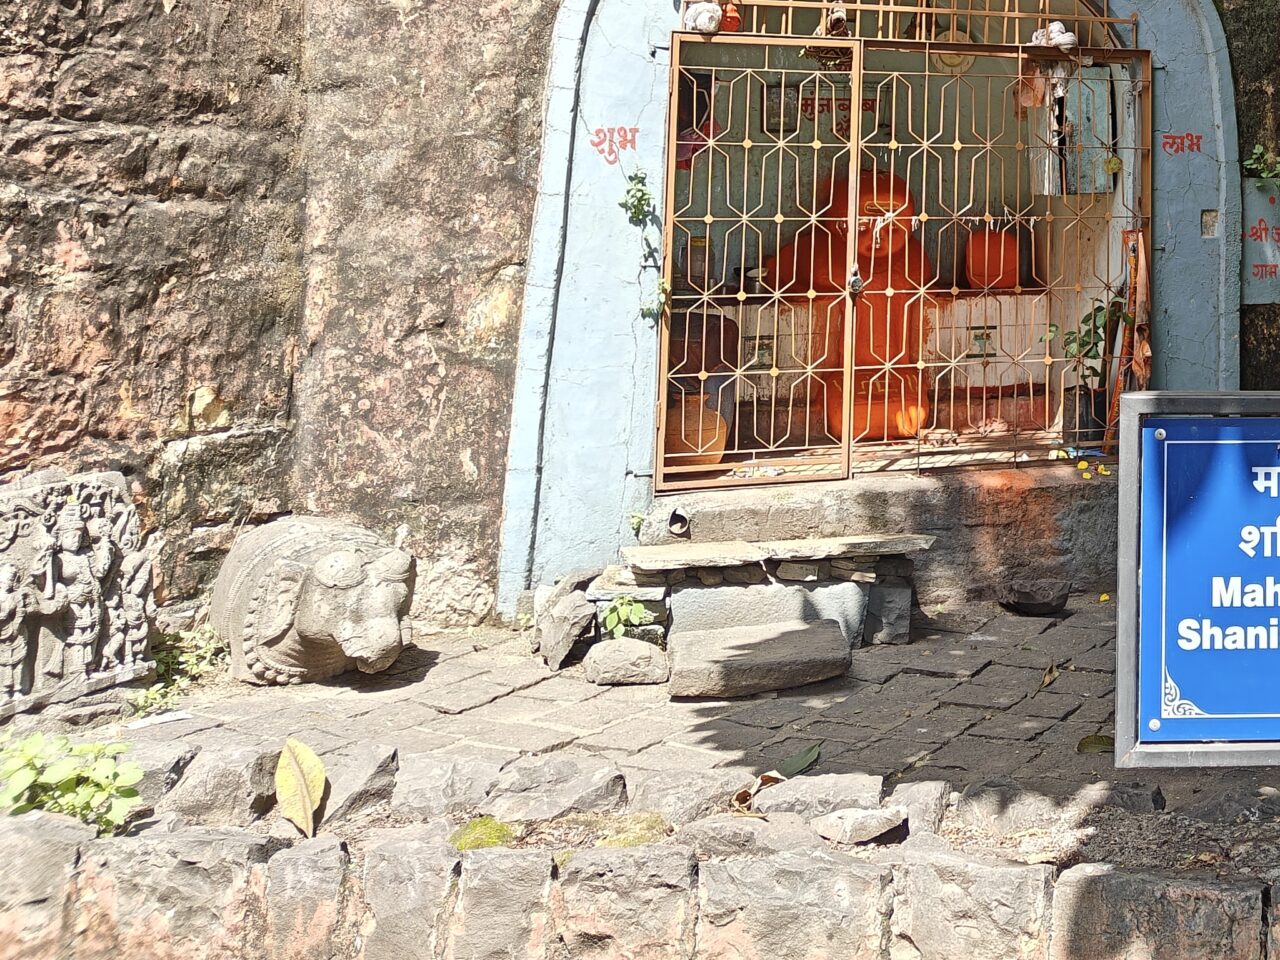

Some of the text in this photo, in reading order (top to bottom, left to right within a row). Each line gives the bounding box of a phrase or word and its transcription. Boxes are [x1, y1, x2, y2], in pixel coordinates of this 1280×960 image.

[590, 126, 639, 165] शुभ
[1162, 132, 1203, 157] लाभ
[1248, 218, 1269, 243] श्री
